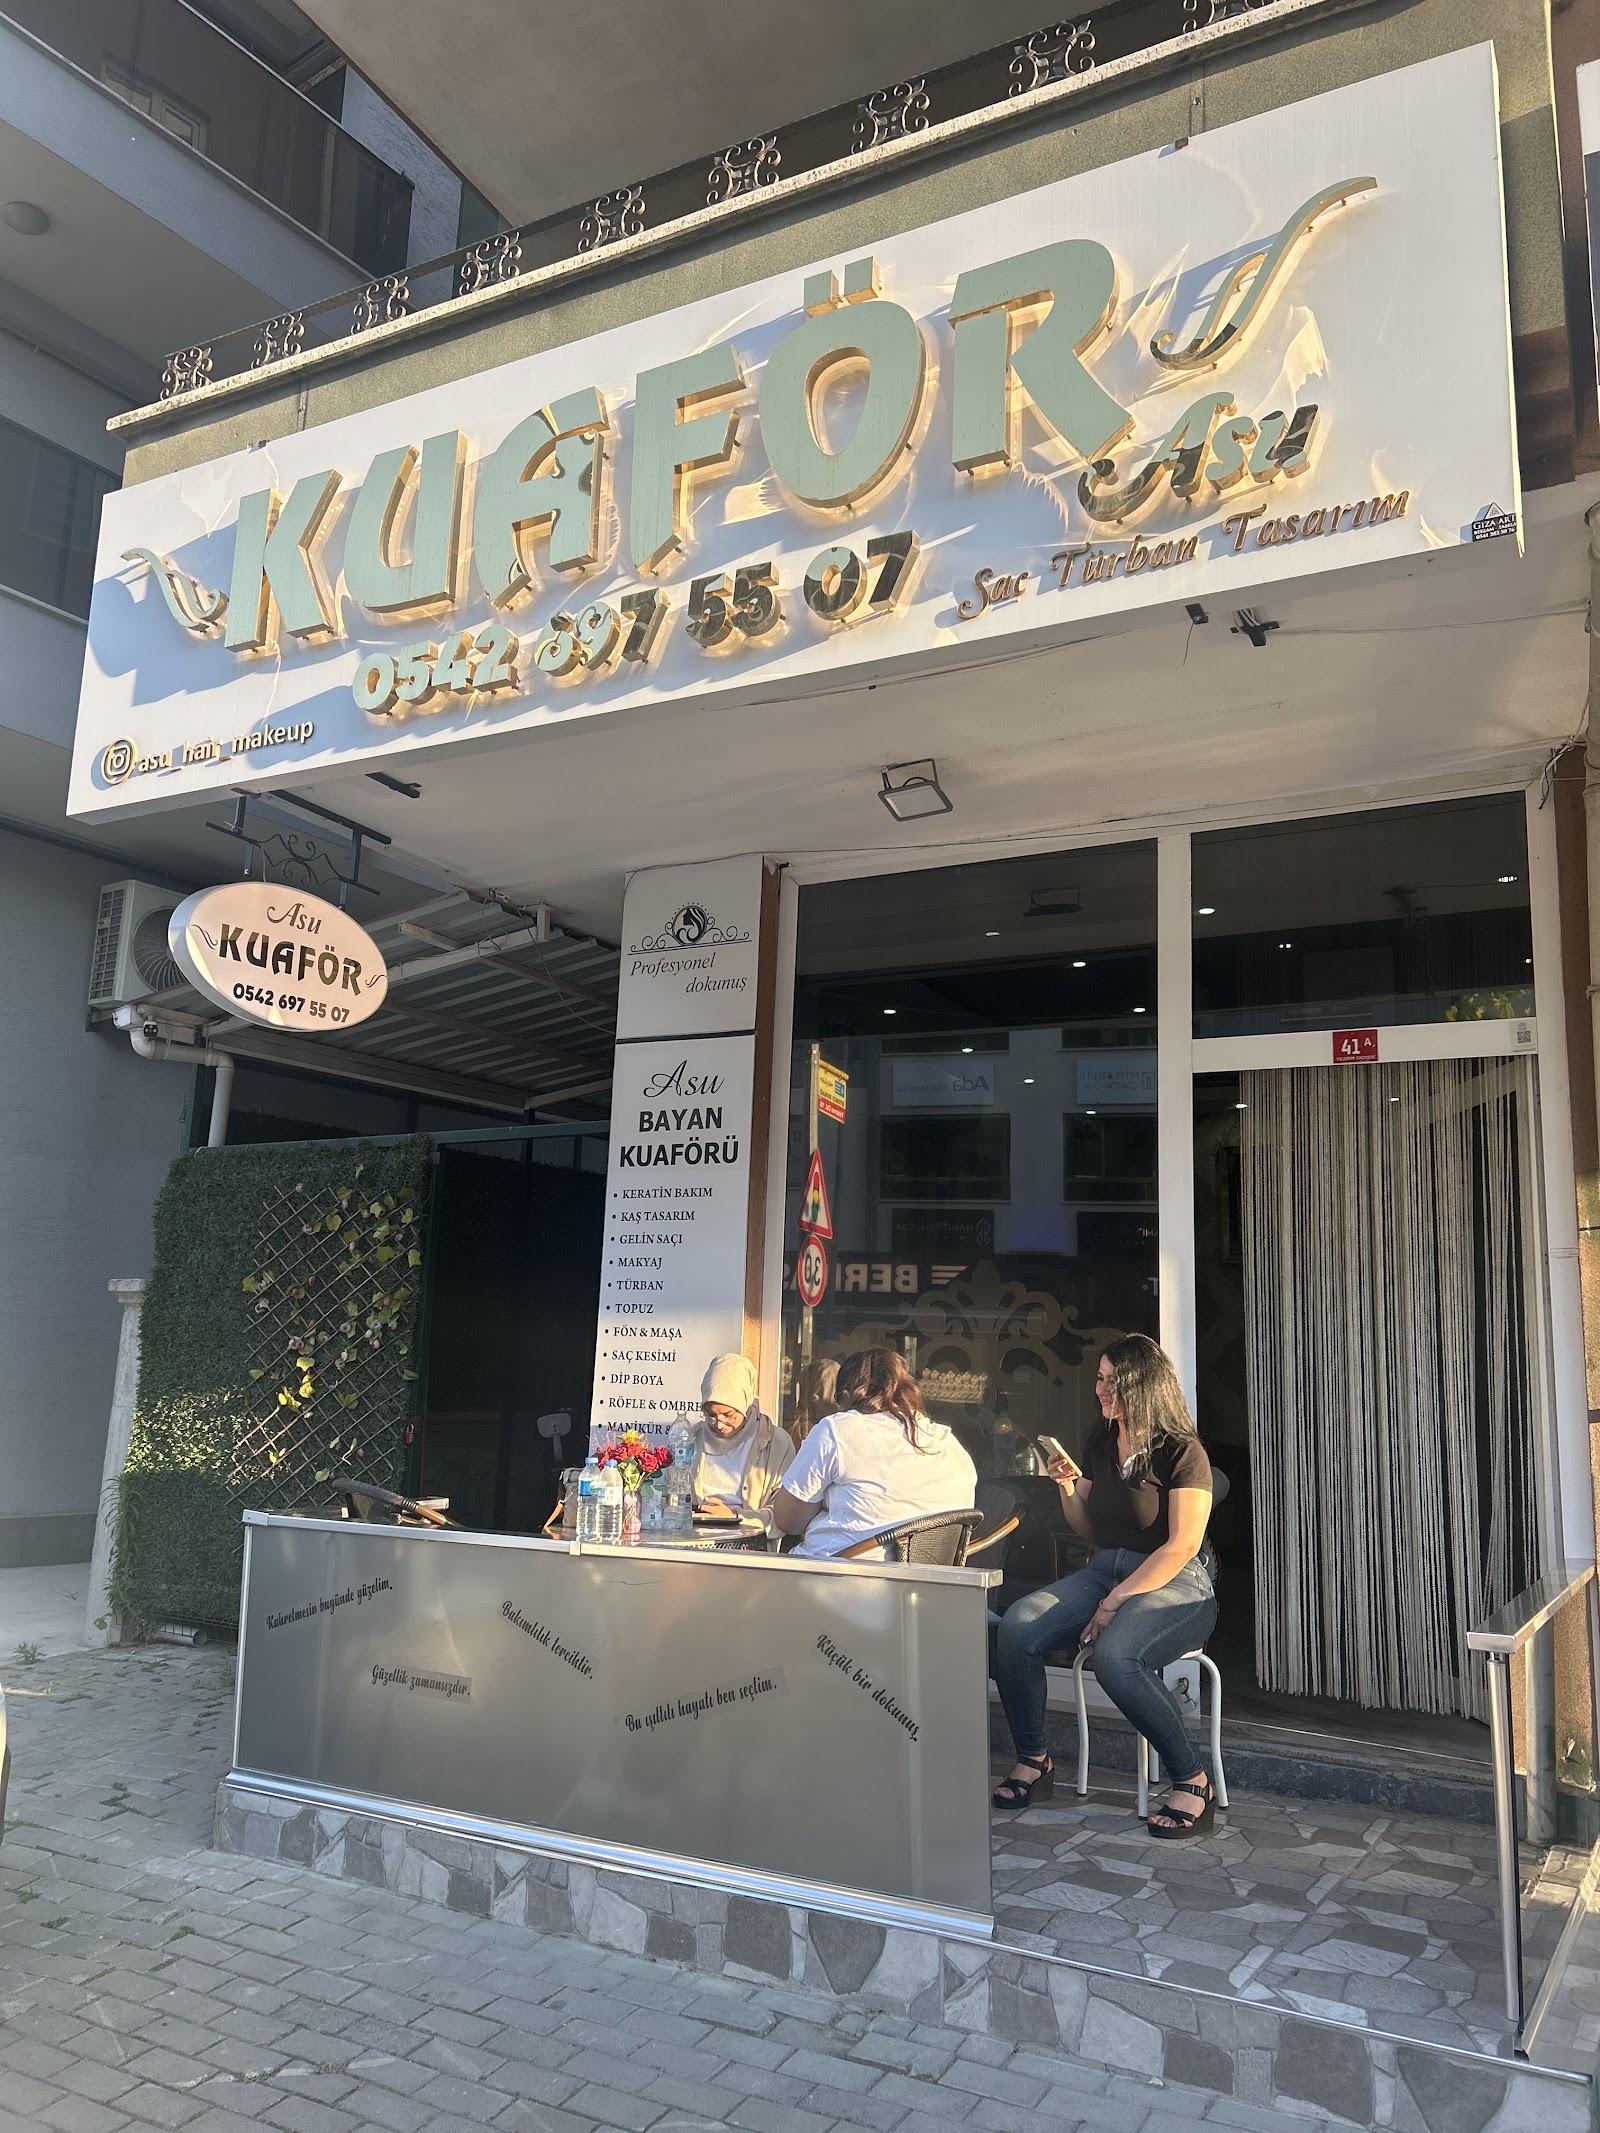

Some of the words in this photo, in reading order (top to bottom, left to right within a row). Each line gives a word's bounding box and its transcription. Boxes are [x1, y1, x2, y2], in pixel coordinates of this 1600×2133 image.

[225, 238, 1136, 652] KUAFÖR
[1078, 391, 1320, 522] Asu
[1473, 519, 1496, 530] GIZA
[1498, 514, 1516, 525] ART
[1049, 535, 1200, 587] Türban
[1222, 490, 1411, 551] Tasarım
[352, 624, 520, 715] 0542
[536, 588, 671, 677] 697
[685, 562, 782, 647] 55
[803, 530, 921, 622] 07
[266, 902, 322, 935] Asu
[218, 923, 362, 997] KUAFÖR
[630, 952, 717, 978] Profesyonel
[685, 975, 748, 994] dokunuş
[233, 982, 274, 1007] 0542
[278, 993, 306, 1013] 697
[309, 1000, 327, 1019] 55
[330, 1006, 350, 1023] 07
[1341, 1038, 1361, 1055] 41
[643, 1059, 726, 1098] Asu
[639, 1107, 723, 1132] BAYAN
[619, 1135, 739, 1168] KUAFÖRÜ
[622, 1186, 673, 1199] KERATİN
[674, 1187, 713, 1198] BAKIM
[620, 1211, 642, 1224] KAŞ
[644, 1210, 696, 1221] TASARIM
[619, 1232, 655, 1244] GELİN
[656, 1233, 684, 1247] SAÇI
[617, 1257, 663, 1270] MAKYAJ
[616, 1278, 664, 1291] TÜRBAN
[614, 1303, 654, 1314] TOPUZ
[613, 1325, 638, 1337] FÖN
[639, 1327, 648, 1337] &
[649, 1327, 683, 1341] MAŞA
[611, 1350, 634, 1364] SAÇ
[635, 1349, 677, 1362] KESİMİ
[609, 1371, 631, 1384] DİP
[632, 1374, 664, 1386] BOYA
[608, 1396, 646, 1409] RÖFLE
[648, 1400, 657, 1410] &
[606, 1420, 663, 1435] MANİKÜR
[266, 1602, 318, 1630] Kahretmesin
[319, 1587, 355, 1615] bugünde
[357, 1577, 393, 1606] güzelim.
[502, 1600, 551, 1647] Bakımlılık
[550, 1637, 593, 1680] tercihtir.
[372, 1664, 408, 1686] Güzellik
[409, 1675, 471, 1698] zamansızdır.
[816, 1634, 853, 1675] Küçük
[852, 1668, 872, 1690] bir
[871, 1688, 920, 1742] dokunuş.
[625, 1714, 642, 1732] Bu
[645, 1702, 676, 1732] ışıltılı
[677, 1691, 714, 1720] hayatı
[716, 1687, 737, 1706] ben
[739, 1676, 777, 1703] seçtim.
